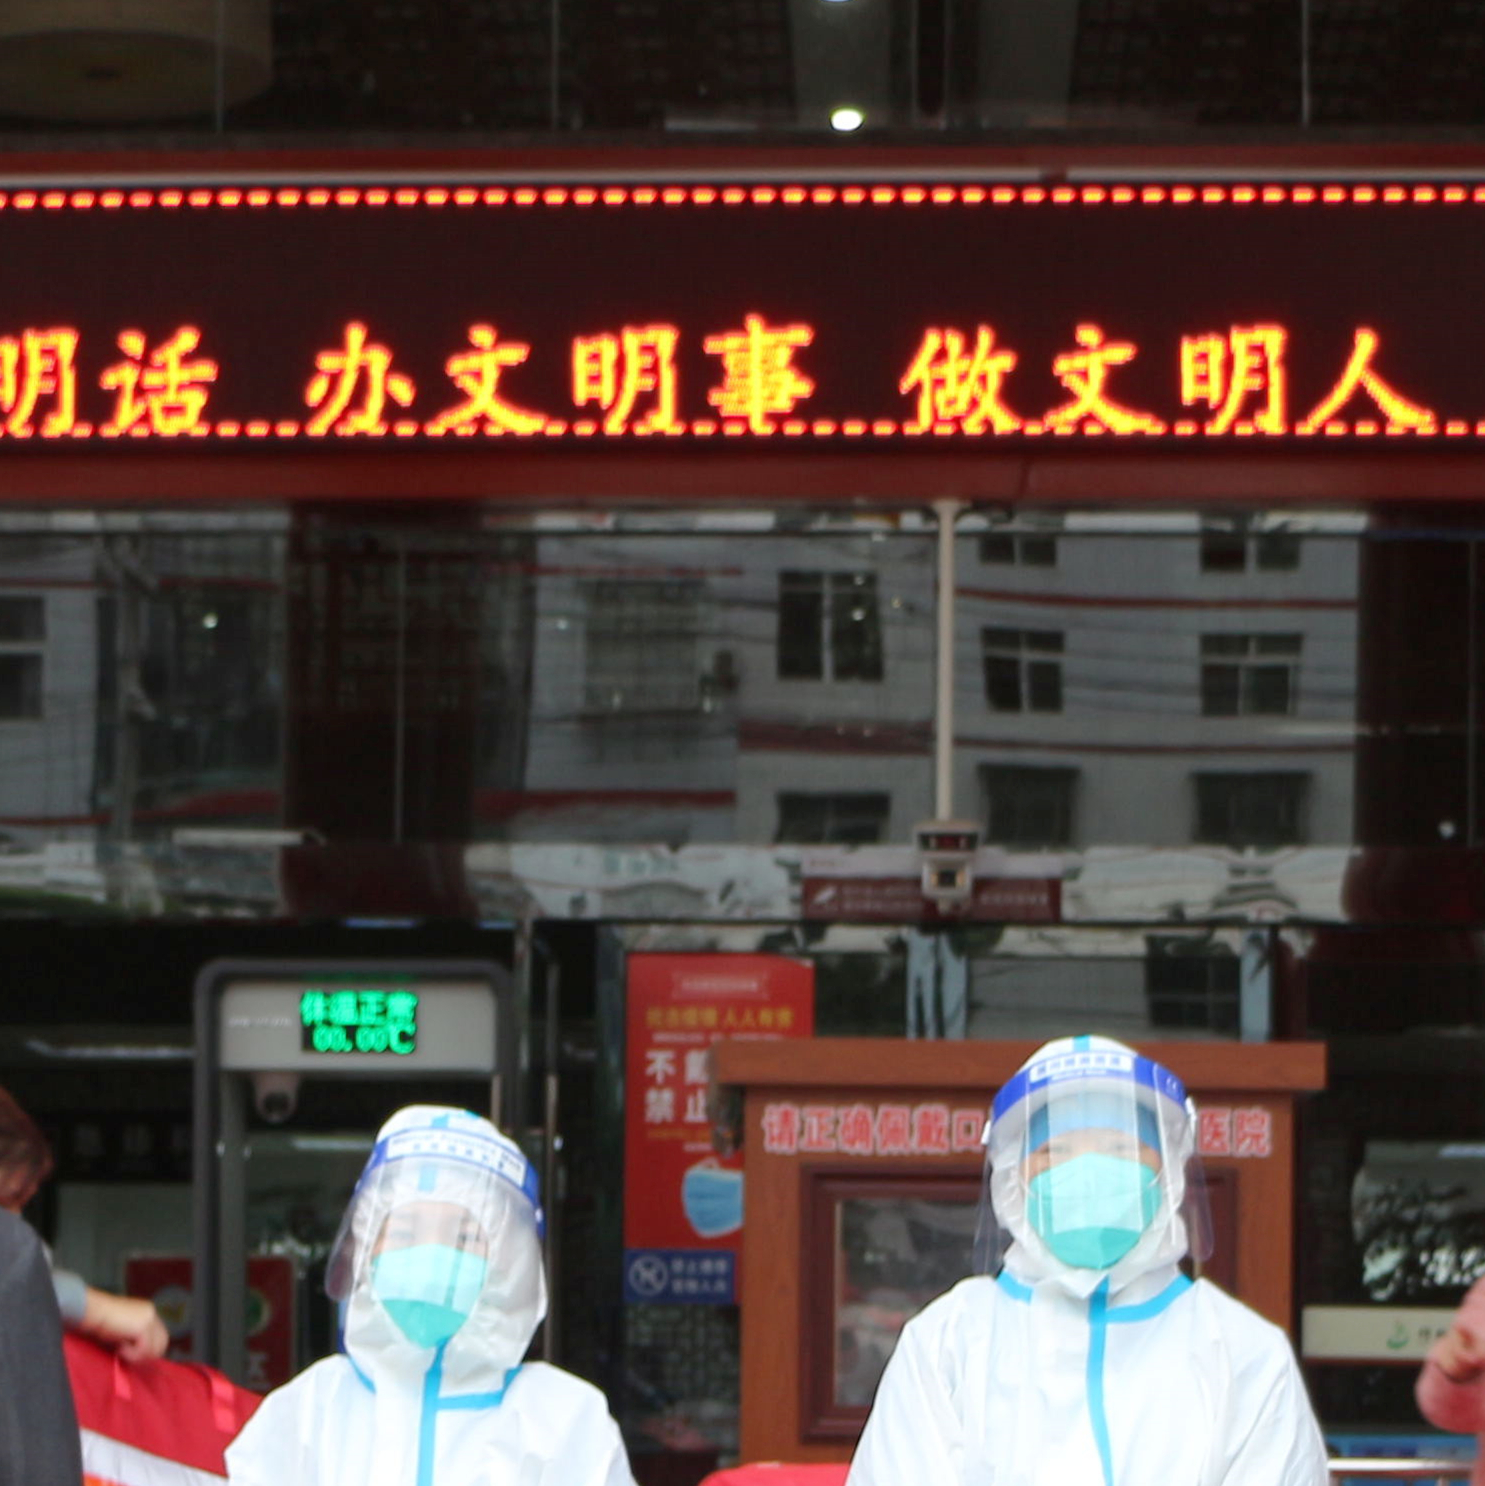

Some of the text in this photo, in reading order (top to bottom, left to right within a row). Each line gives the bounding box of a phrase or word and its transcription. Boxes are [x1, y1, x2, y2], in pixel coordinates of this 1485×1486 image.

[303, 314, 816, 438] 办文明事
[899, 324, 1436, 434] 做文明人
